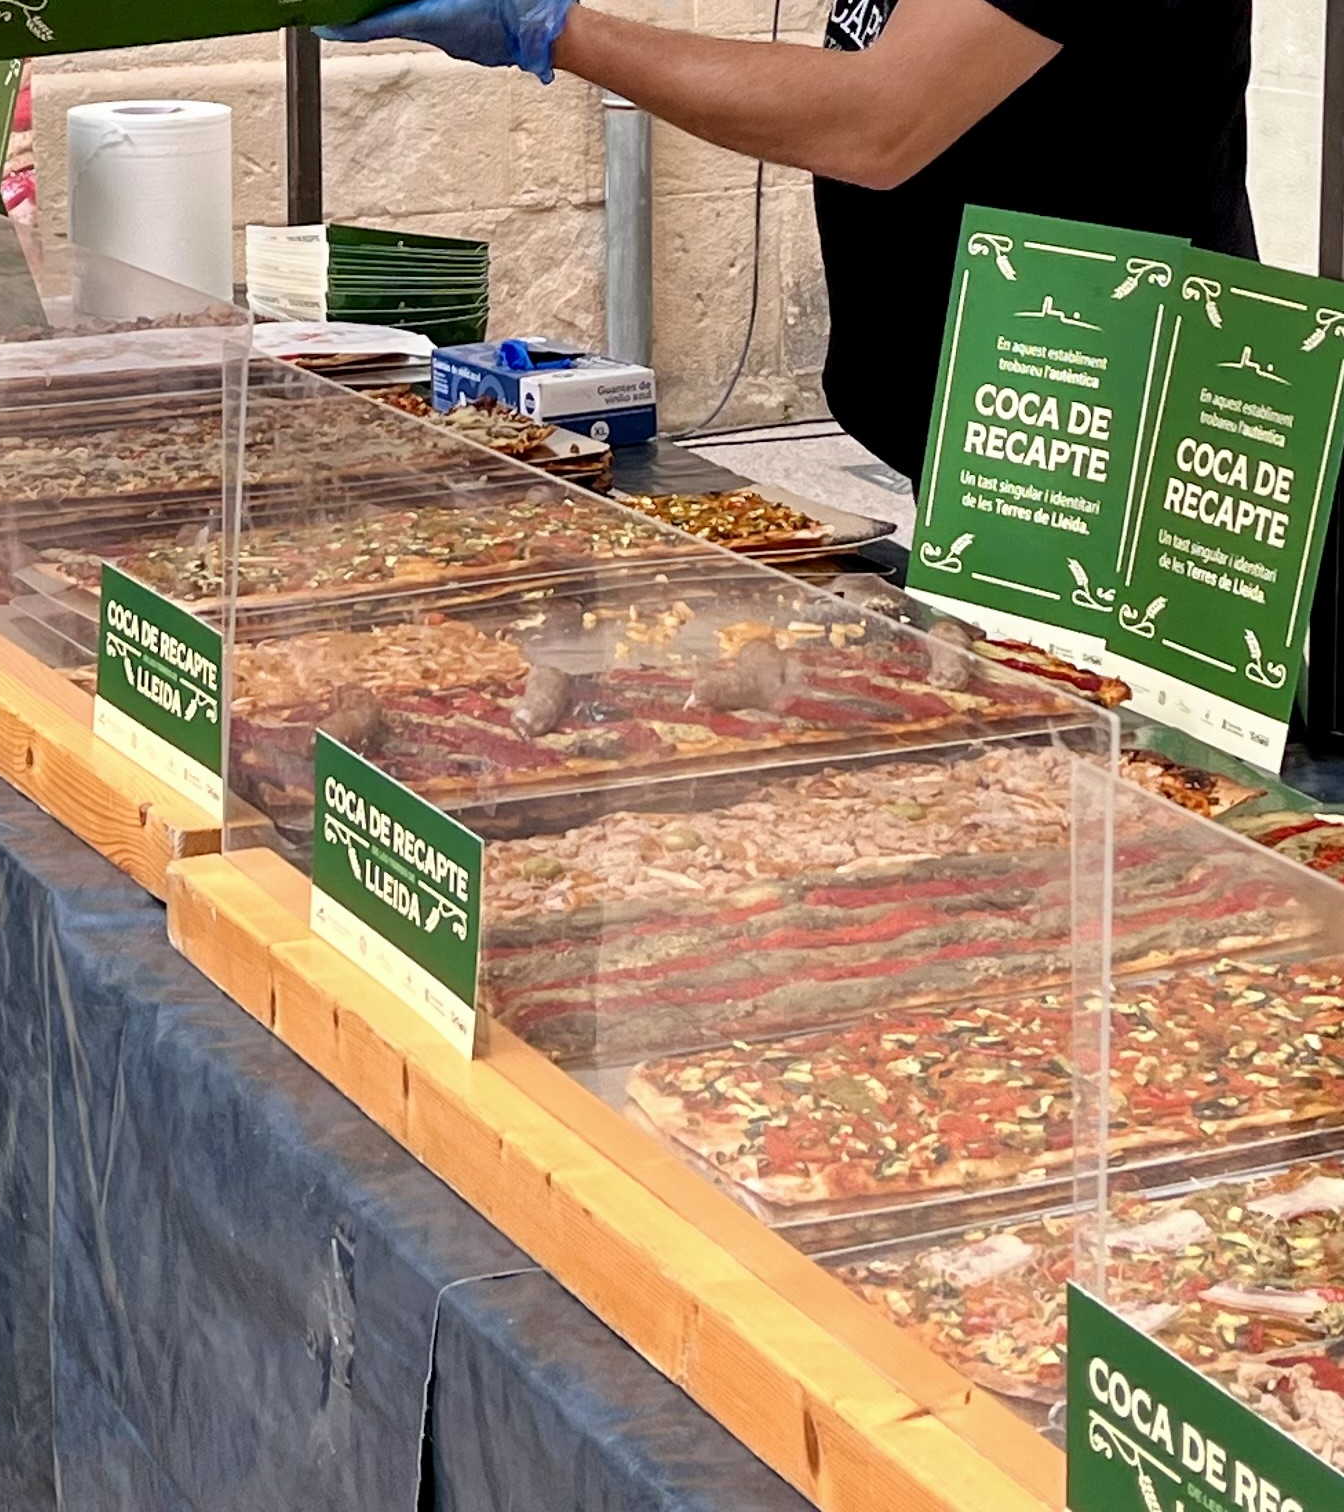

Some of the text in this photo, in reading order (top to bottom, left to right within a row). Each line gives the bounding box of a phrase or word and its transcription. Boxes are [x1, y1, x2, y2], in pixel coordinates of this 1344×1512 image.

[997, 335, 1108, 370] En aquest establiment
[999, 357, 1043, 377] trobareu
[975, 383, 1113, 441] COCA DE
[963, 421, 1110, 483] RECAPTE
[1176, 437, 1295, 505] COCA DE
[960, 469, 976, 486] Un
[977, 474, 999, 491] tast
[999, 479, 1044, 503] singular
[1050, 490, 1101, 515] identitari
[961, 492, 977, 508] de
[977, 495, 993, 512] les
[995, 498, 1032, 522] Terres
[1033, 507, 1050, 526] de
[1163, 477, 1290, 549] RECAPTE
[1157, 528, 1172, 546] Un
[1158, 552, 1172, 570] de
[1186, 560, 1218, 588] Terres
[1218, 573, 1232, 592] de
[107, 599, 140, 642] COCA
[141, 619, 159, 653] DE
[159, 630, 218, 691] RECAPTE
[136, 665, 182, 718] LLEIDA
[324, 776, 367, 831] COCA
[369, 804, 391, 848] DE
[392, 822, 469, 903] RECAPTE
[365, 858, 422, 927] LLEIDA
[1088, 1356, 1175, 1456] COCA
[1182, 1422, 1227, 1493] DE
